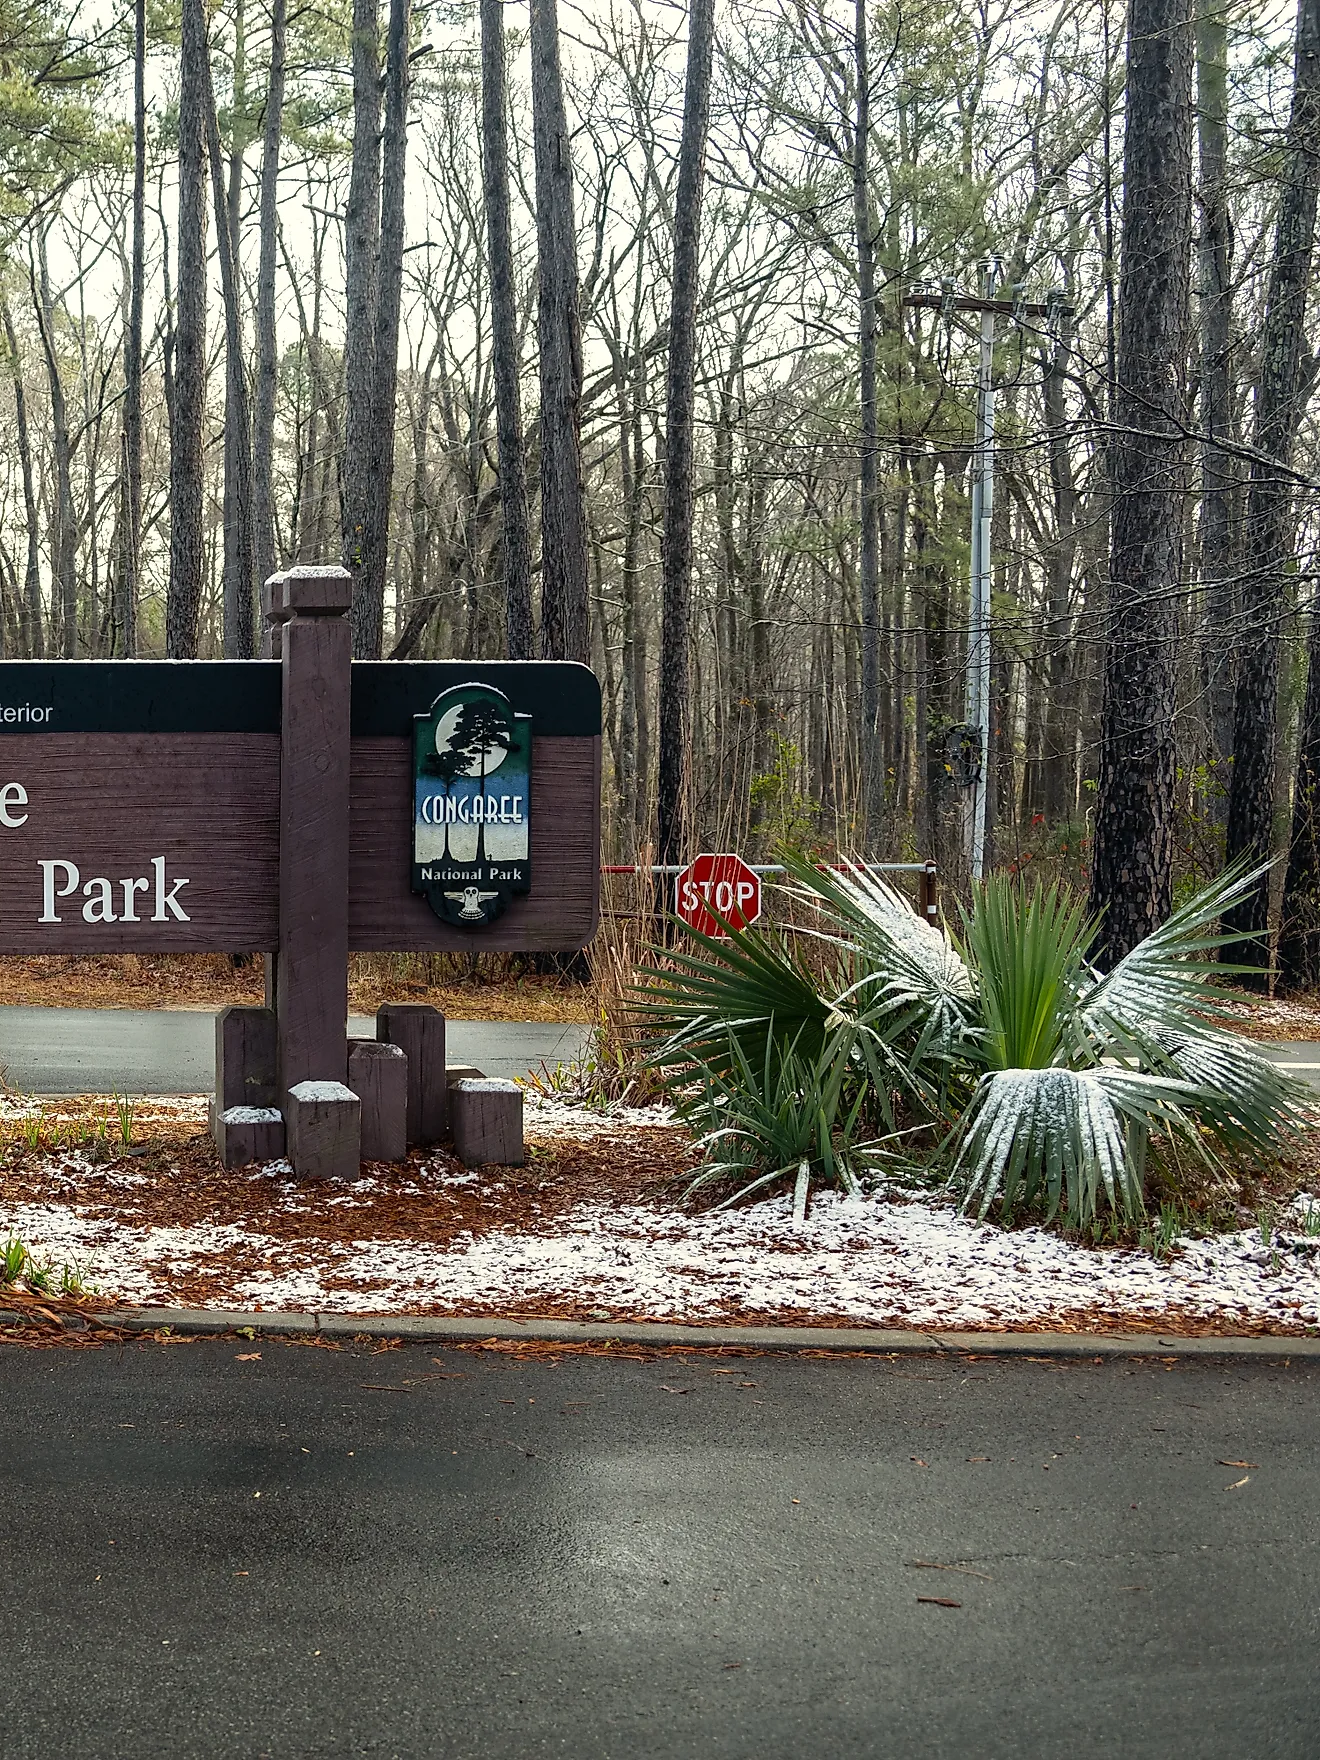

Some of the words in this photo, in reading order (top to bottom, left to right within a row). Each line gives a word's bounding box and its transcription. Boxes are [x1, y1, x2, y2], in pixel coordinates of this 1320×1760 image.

[421, 795, 523, 824] CONGAREE
[421, 868, 482, 880] National
[489, 867, 522, 880] Park
[37, 855, 191, 924] Park
[681, 881, 755, 912] STOP
